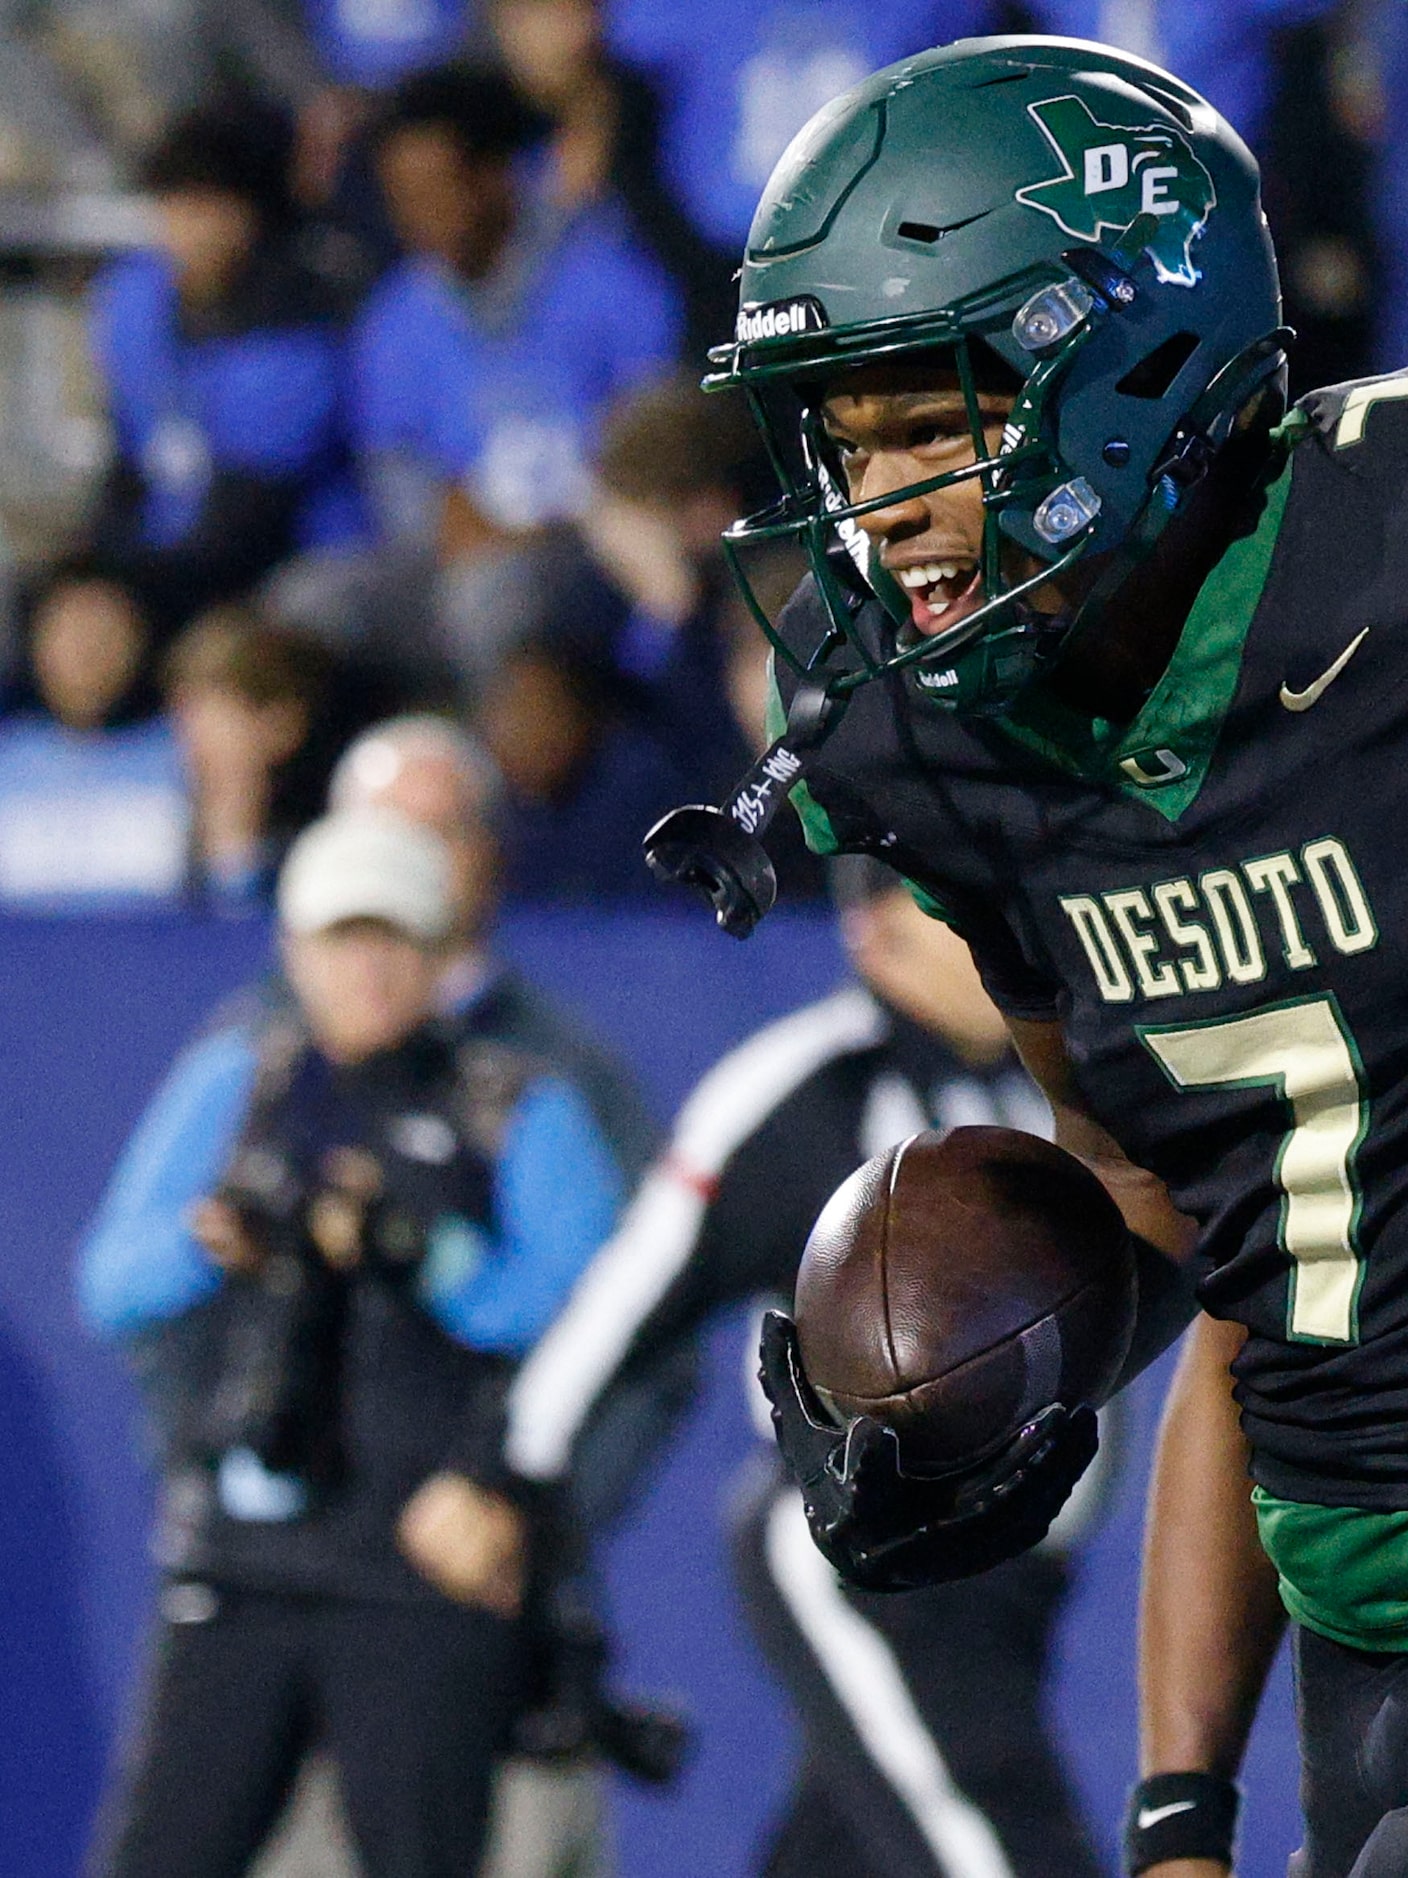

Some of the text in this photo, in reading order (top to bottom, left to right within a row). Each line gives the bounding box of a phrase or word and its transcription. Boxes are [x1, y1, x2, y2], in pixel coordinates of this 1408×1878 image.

[736, 302, 806, 341] Riddell
[1057, 834, 1379, 1004] DESOTO
[1134, 990, 1370, 1348] 7
